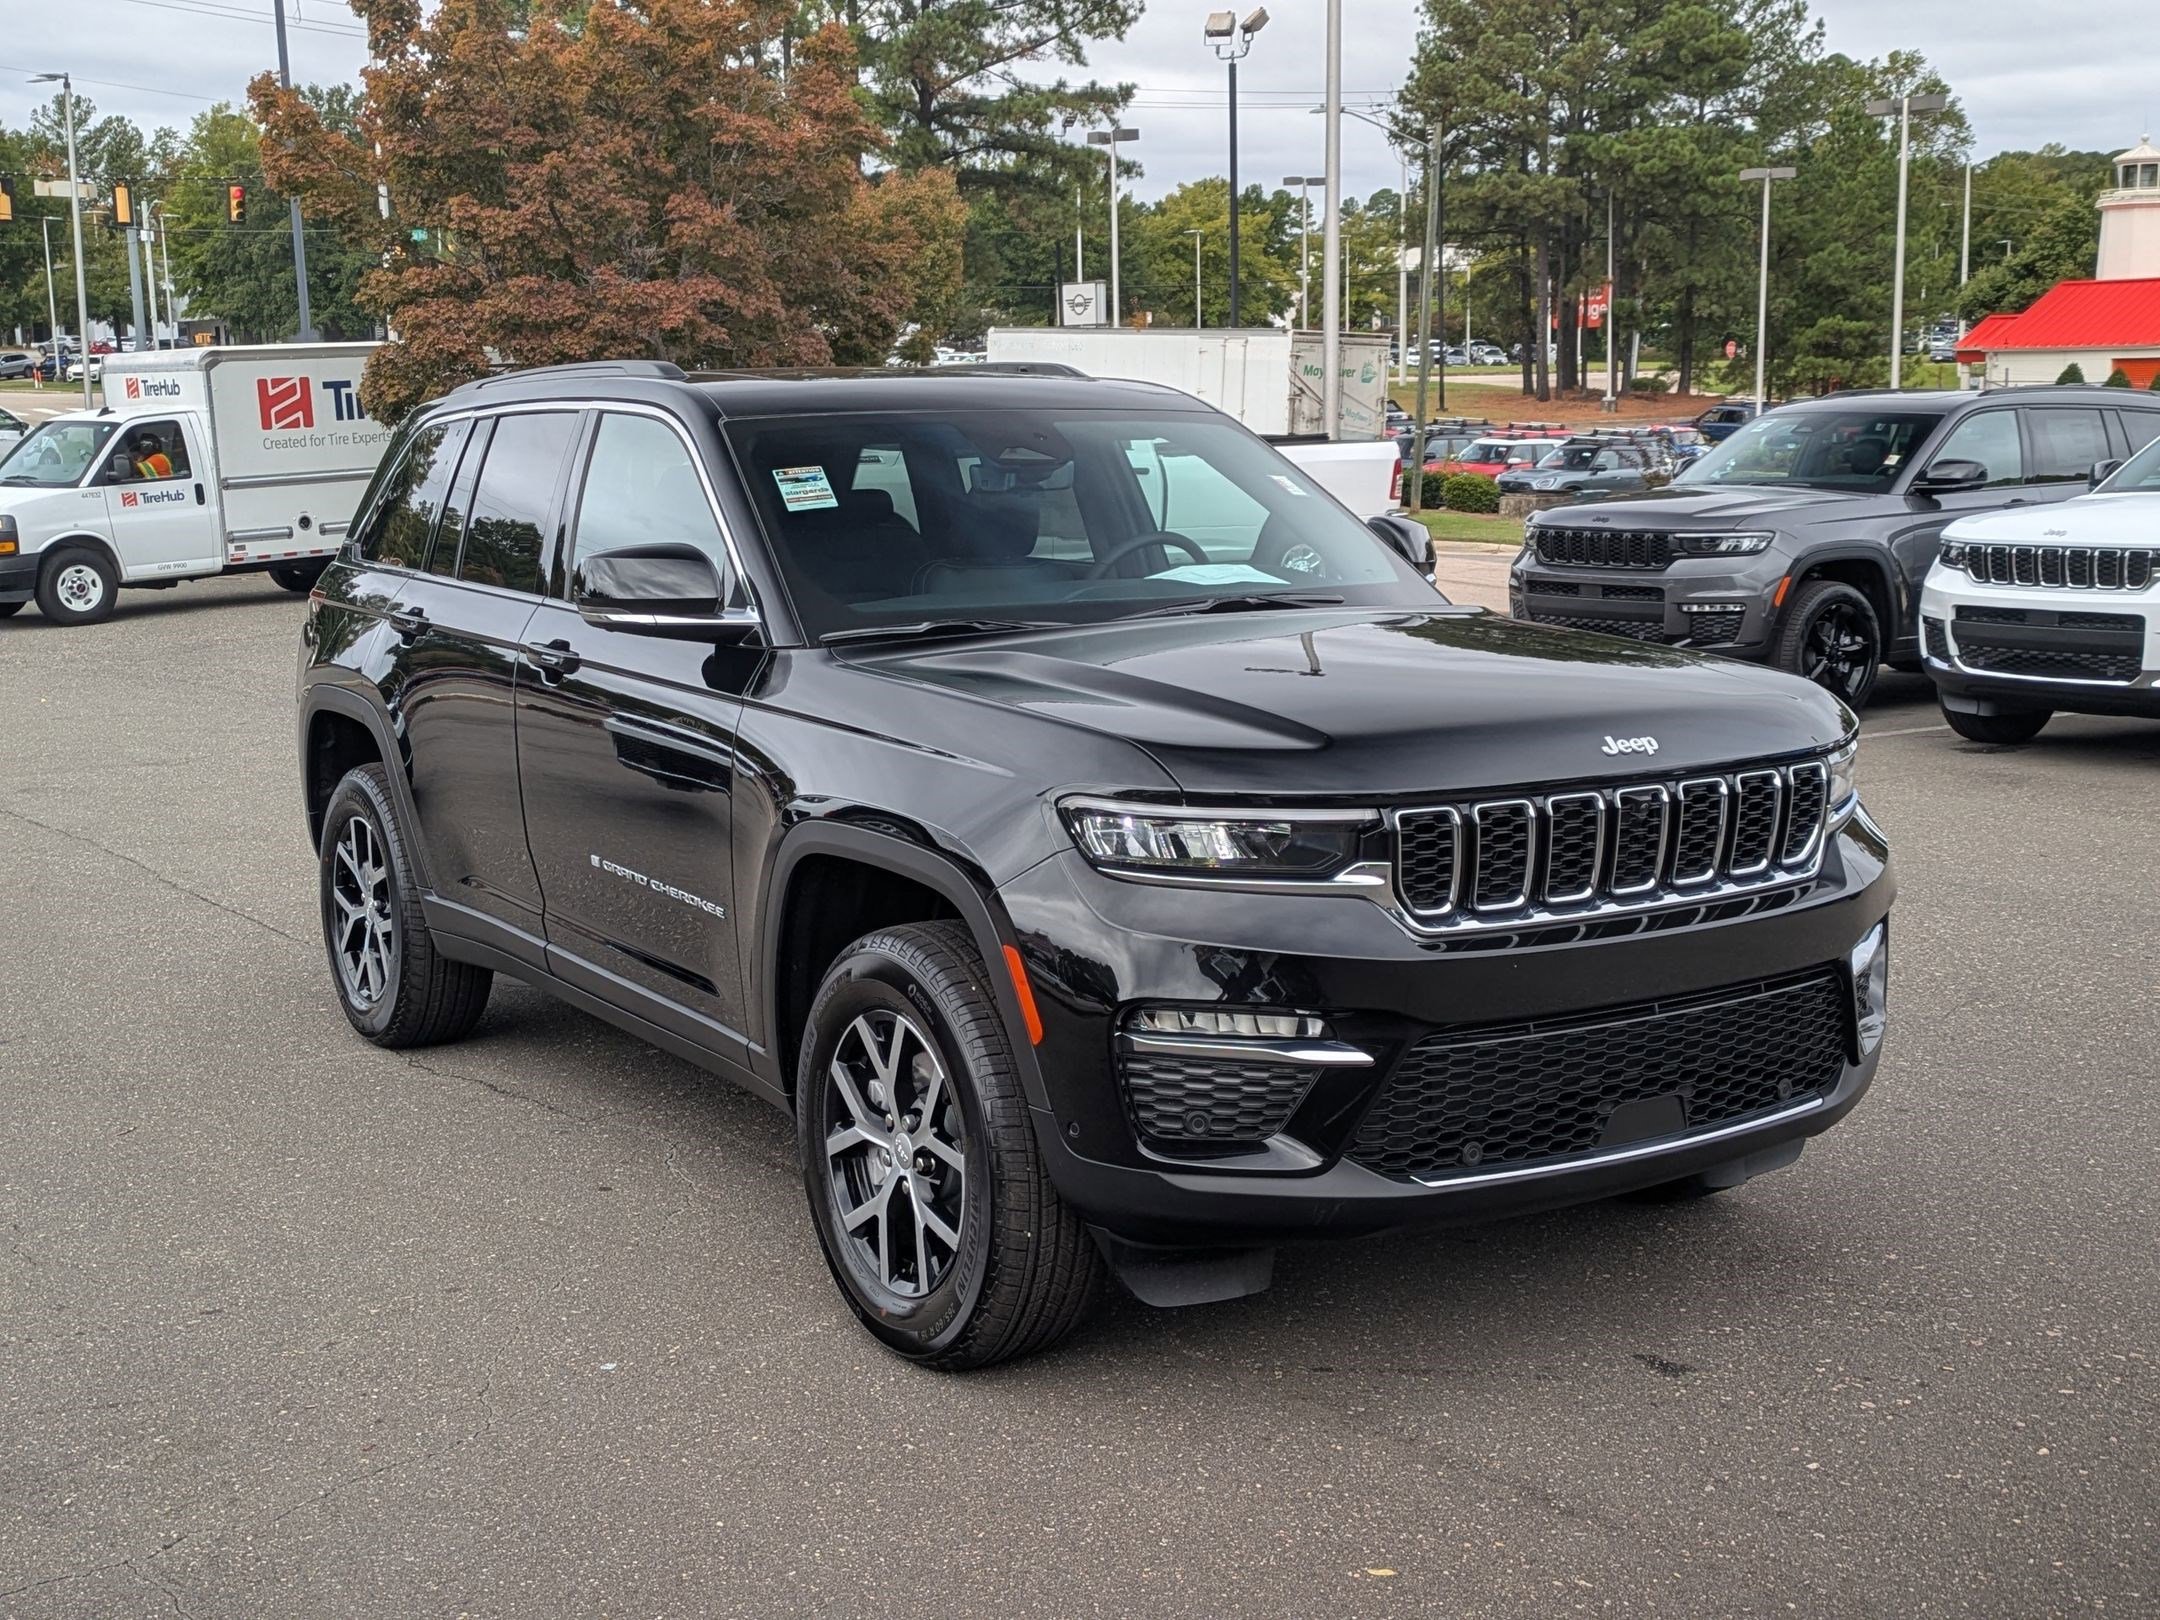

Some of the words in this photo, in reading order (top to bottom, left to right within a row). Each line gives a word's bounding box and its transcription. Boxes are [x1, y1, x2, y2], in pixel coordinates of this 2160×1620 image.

[141, 379, 180, 396] TireHub
[263, 435, 307, 450] Created
[310, 434, 325, 446] for
[328, 432, 349, 445] Tire
[352, 431, 391, 446] Experts
[140, 490, 185, 504] TireHub
[1601, 735, 1659, 756] Jeep
[602, 860, 648, 886] GRAND
[650, 879, 726, 919] CHEROKEE
[958, 1192, 978, 1297] MICHELIN
